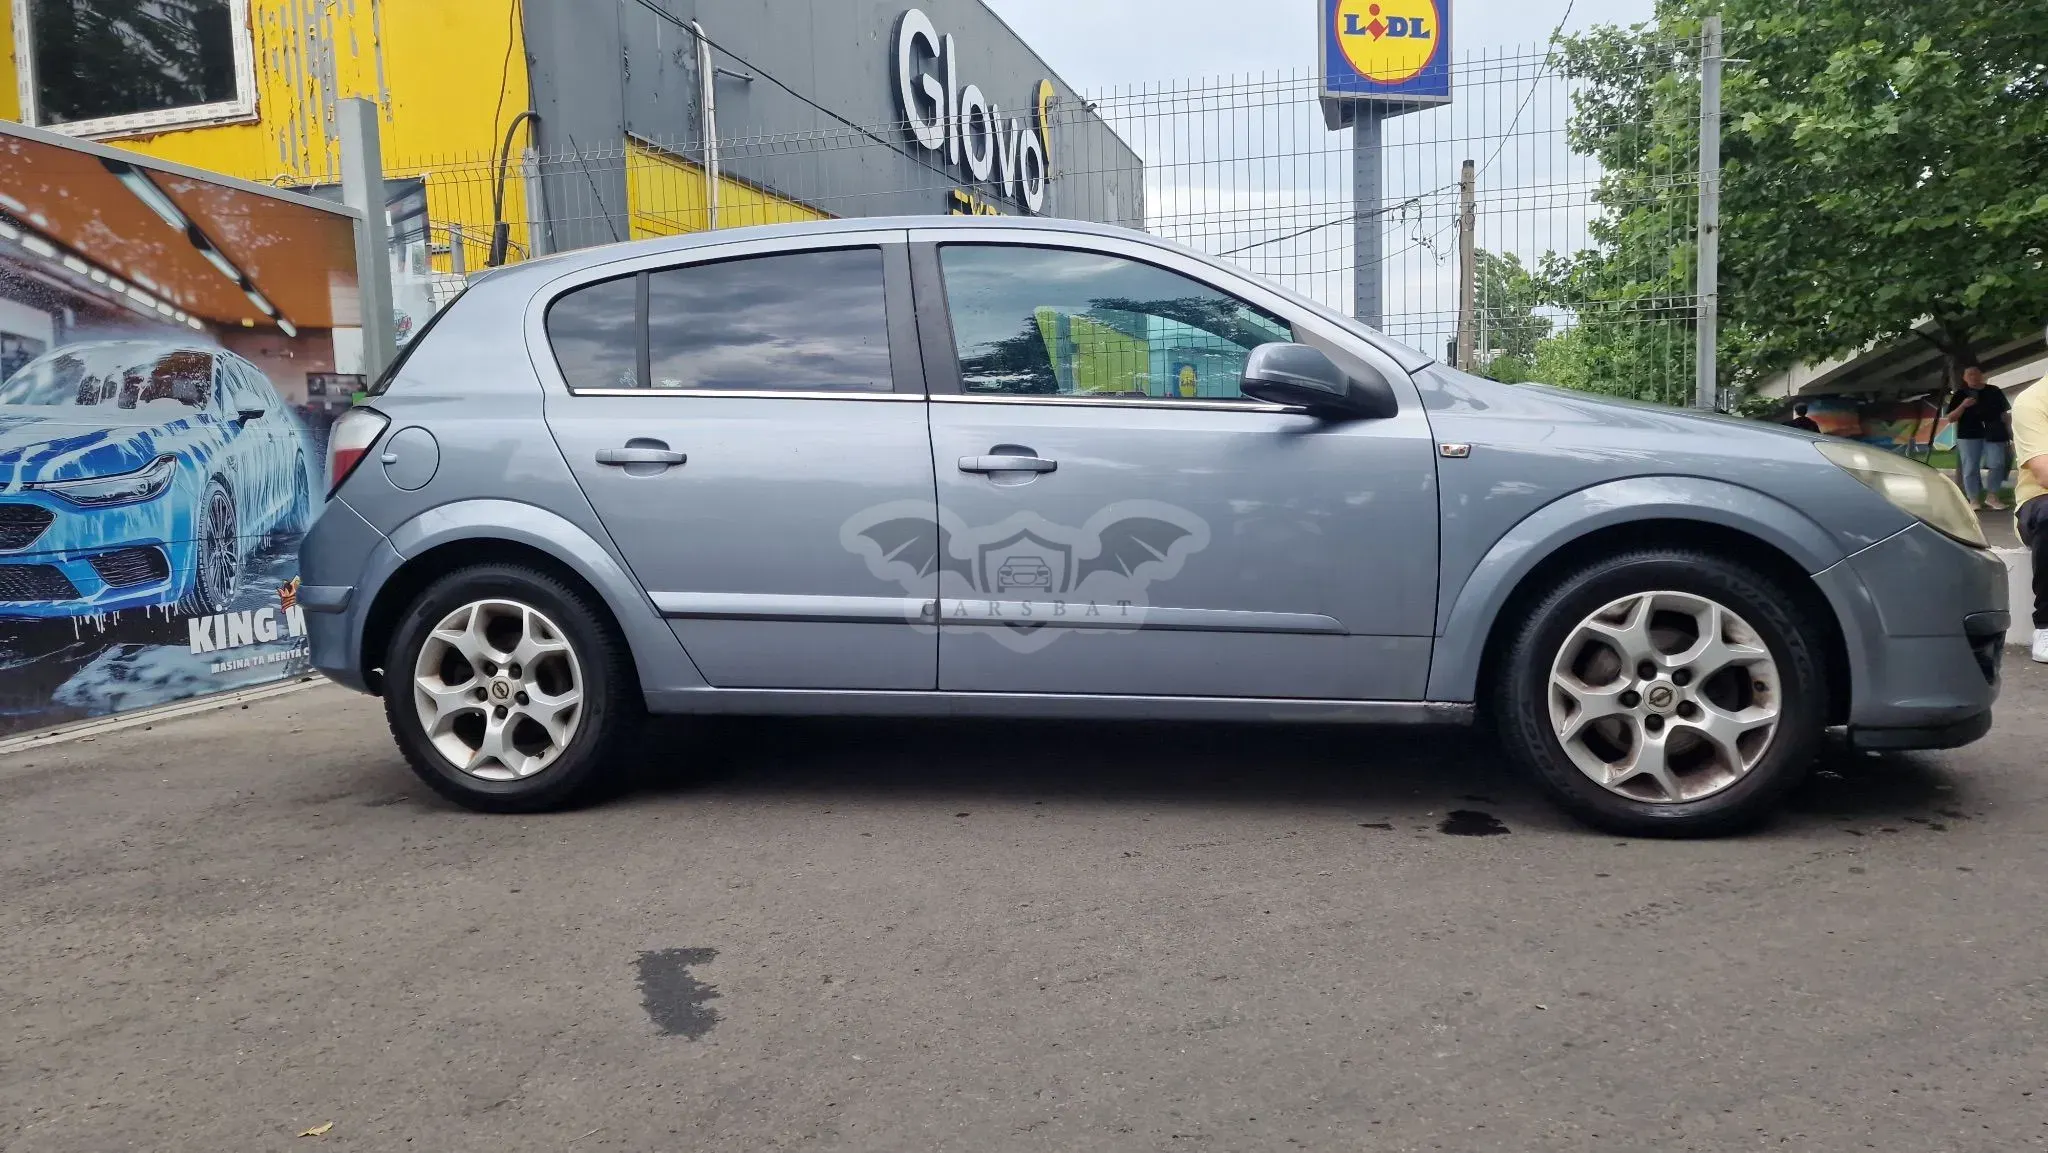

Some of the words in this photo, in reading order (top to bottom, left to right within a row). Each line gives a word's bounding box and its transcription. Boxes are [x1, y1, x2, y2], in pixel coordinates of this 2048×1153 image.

[893, 8, 1045, 214] Glovo
[188, 607, 278, 655] KING
[286, 605, 308, 637] W
[211, 658, 251, 674] MASINA
[253, 655, 265, 665] TA
[267, 648, 302, 663] MERITA
